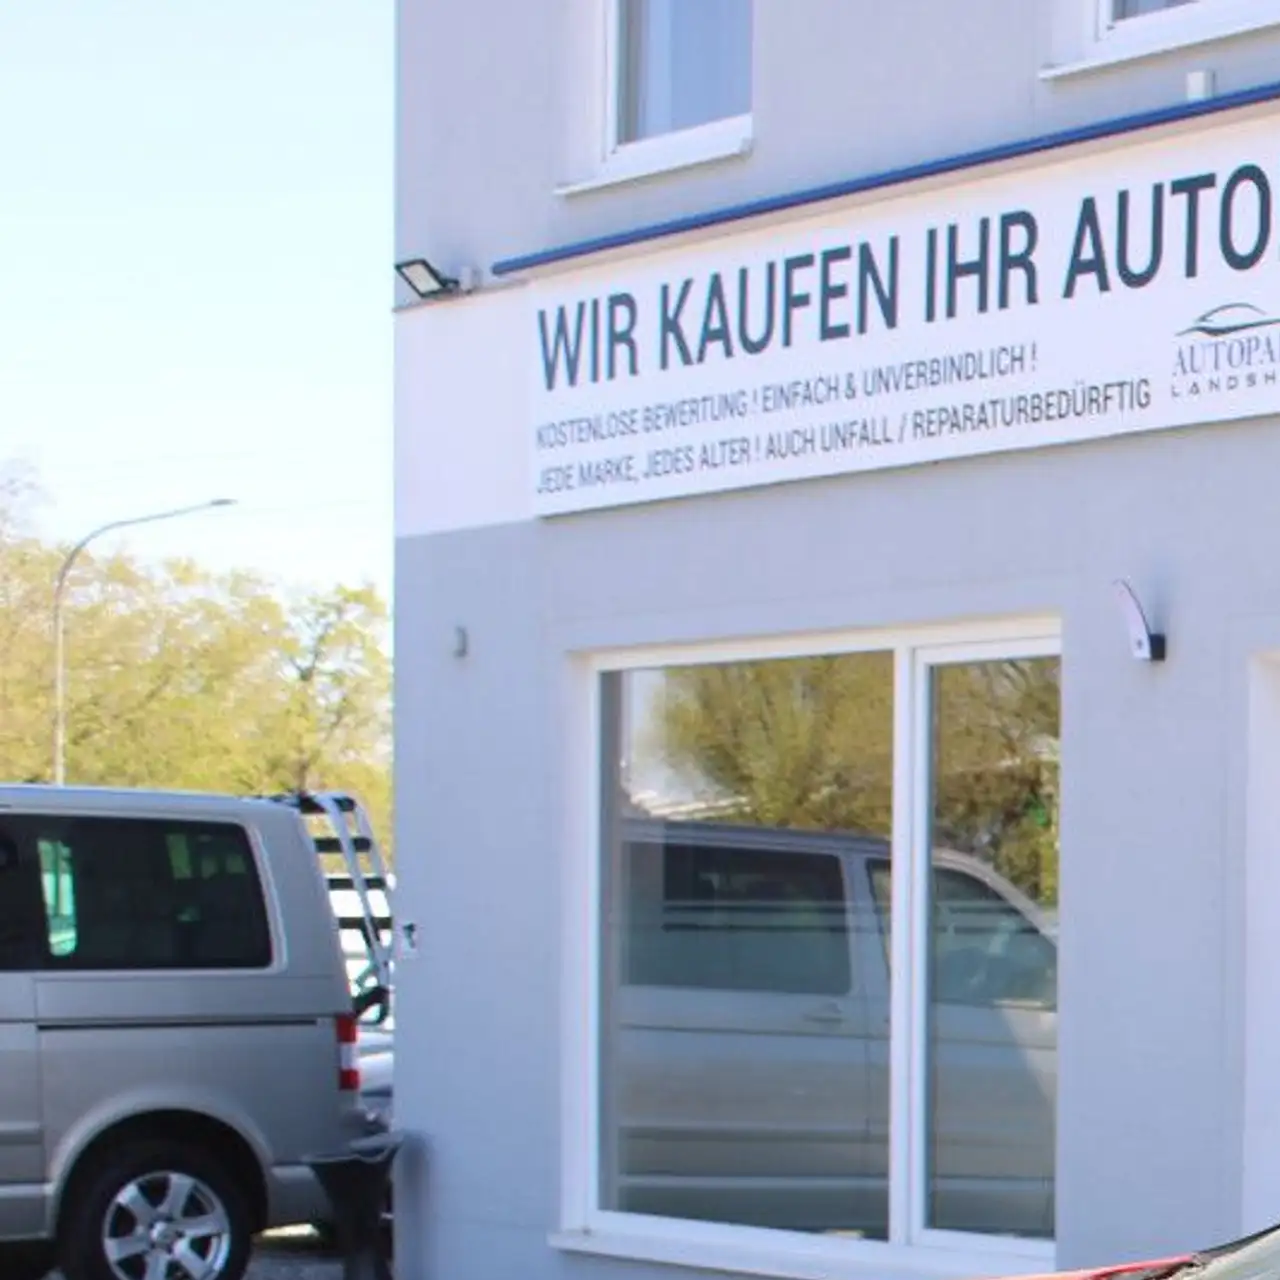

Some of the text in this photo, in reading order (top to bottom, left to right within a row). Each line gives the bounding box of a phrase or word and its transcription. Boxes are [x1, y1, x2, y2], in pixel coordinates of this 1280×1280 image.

[538, 291, 637, 391] WIR
[660, 235, 900, 370] KAUFEN
[925, 210, 1038, 323] IHR
[536, 407, 639, 449] KOSTENLOSE
[643, 389, 748, 434] BEWERTUNG
[763, 373, 839, 413] EINFACH
[845, 372, 856, 400] &
[864, 343, 1024, 397] UNVERBINDLICH
[537, 464, 575, 493] JEDE
[578, 454, 640, 488] MARKE,
[643, 445, 695, 480] JEDES
[700, 436, 750, 470] ALTER
[766, 424, 816, 461] AUCH
[820, 415, 895, 454] UNFALL
[912, 377, 1151, 440] REPARATURBEDÜRFTIG
